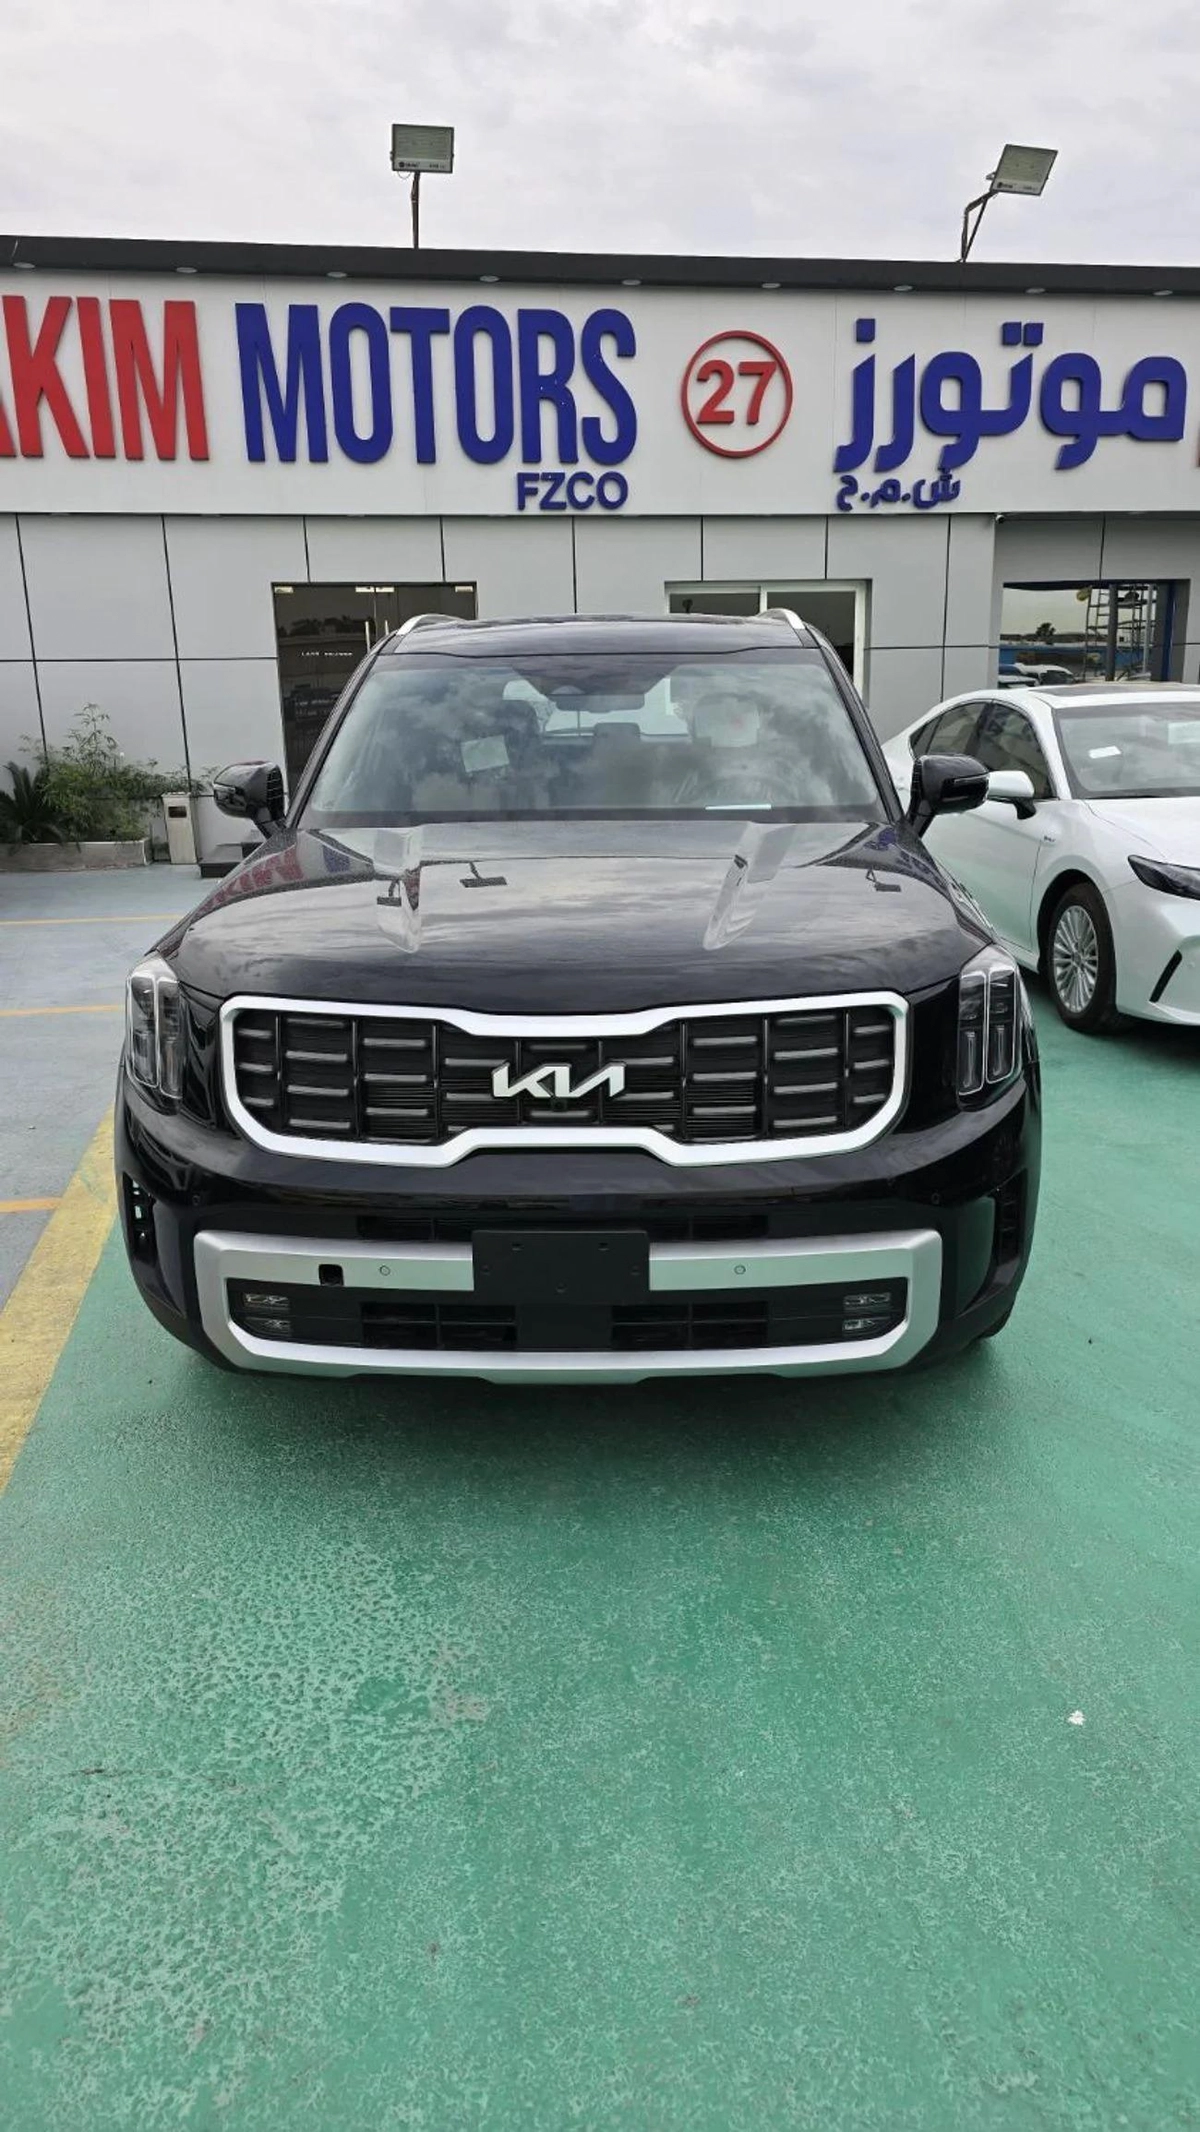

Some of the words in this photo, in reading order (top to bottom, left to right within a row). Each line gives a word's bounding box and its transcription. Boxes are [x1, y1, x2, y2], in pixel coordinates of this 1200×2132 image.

[0, 295, 209, 460] KIM
[235, 303, 638, 465] MOTORS
[696, 358, 780, 426] 27
[833, 318, 1188, 472] موتورز
[517, 470, 629, 511] FZCO
[491, 1060, 627, 1098] KIA
